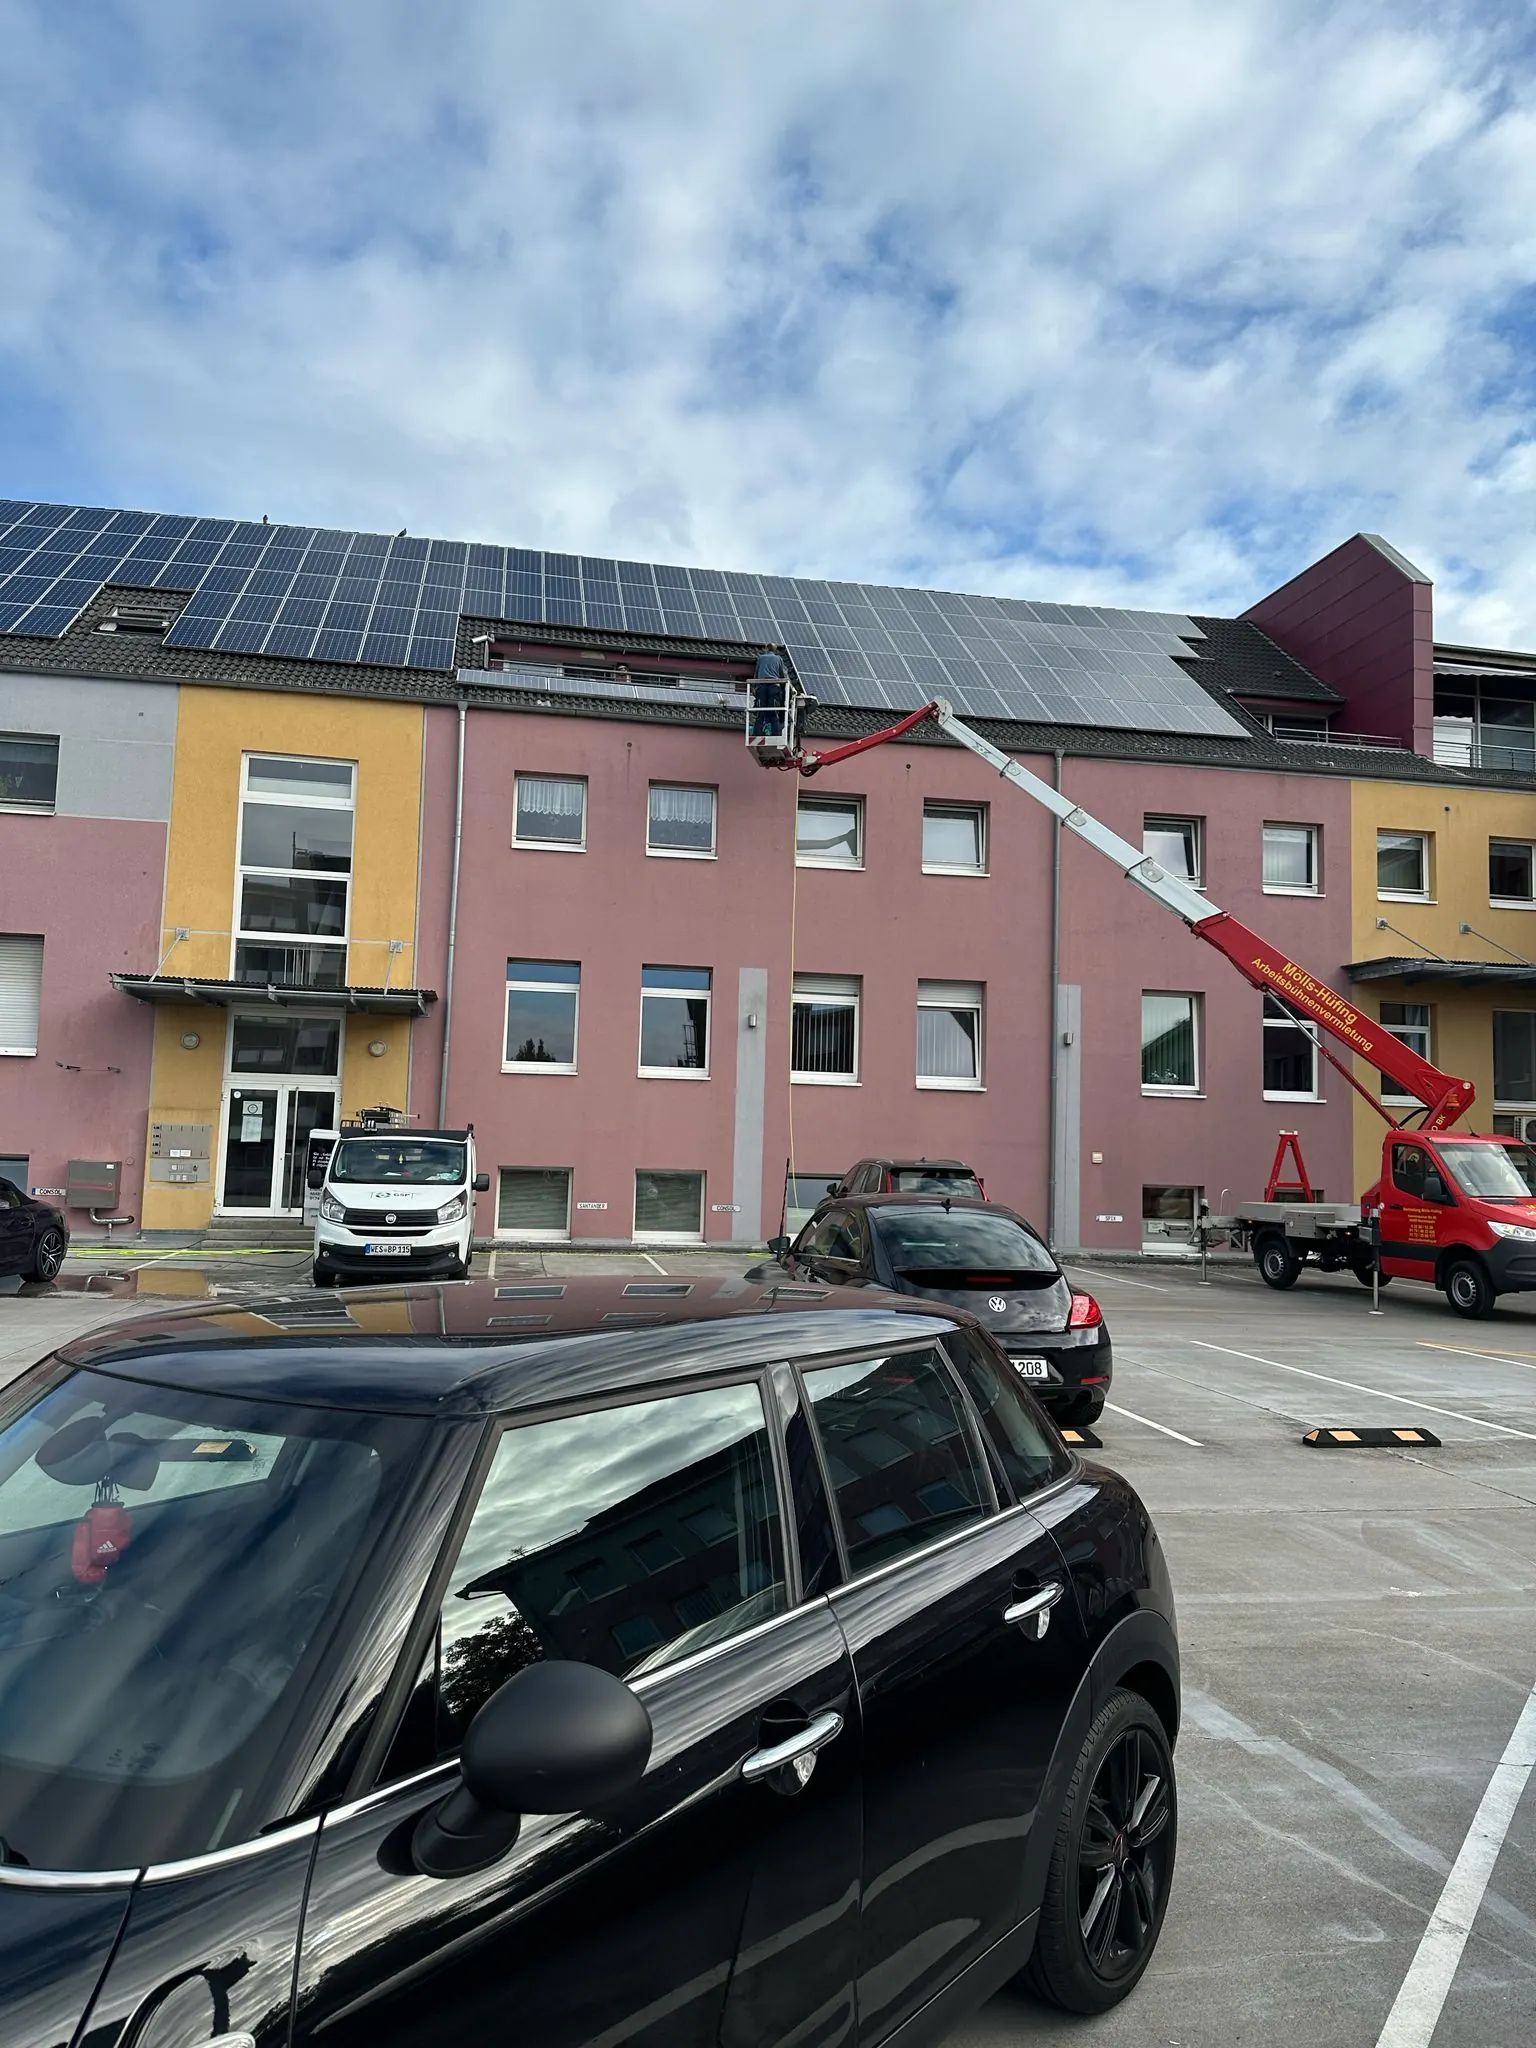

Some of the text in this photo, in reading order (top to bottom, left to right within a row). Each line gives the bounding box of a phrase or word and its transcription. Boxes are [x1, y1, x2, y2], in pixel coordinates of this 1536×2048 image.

[1282, 962, 1358, 1024] Mölls-Hüfing
[1251, 958, 1374, 1051] Arbeitsbühnenvermietung
[1435, 1114, 1446, 1125] BK
[387, 1245, 397, 1254] BP
[1018, 1361, 1042, 1375] 208
